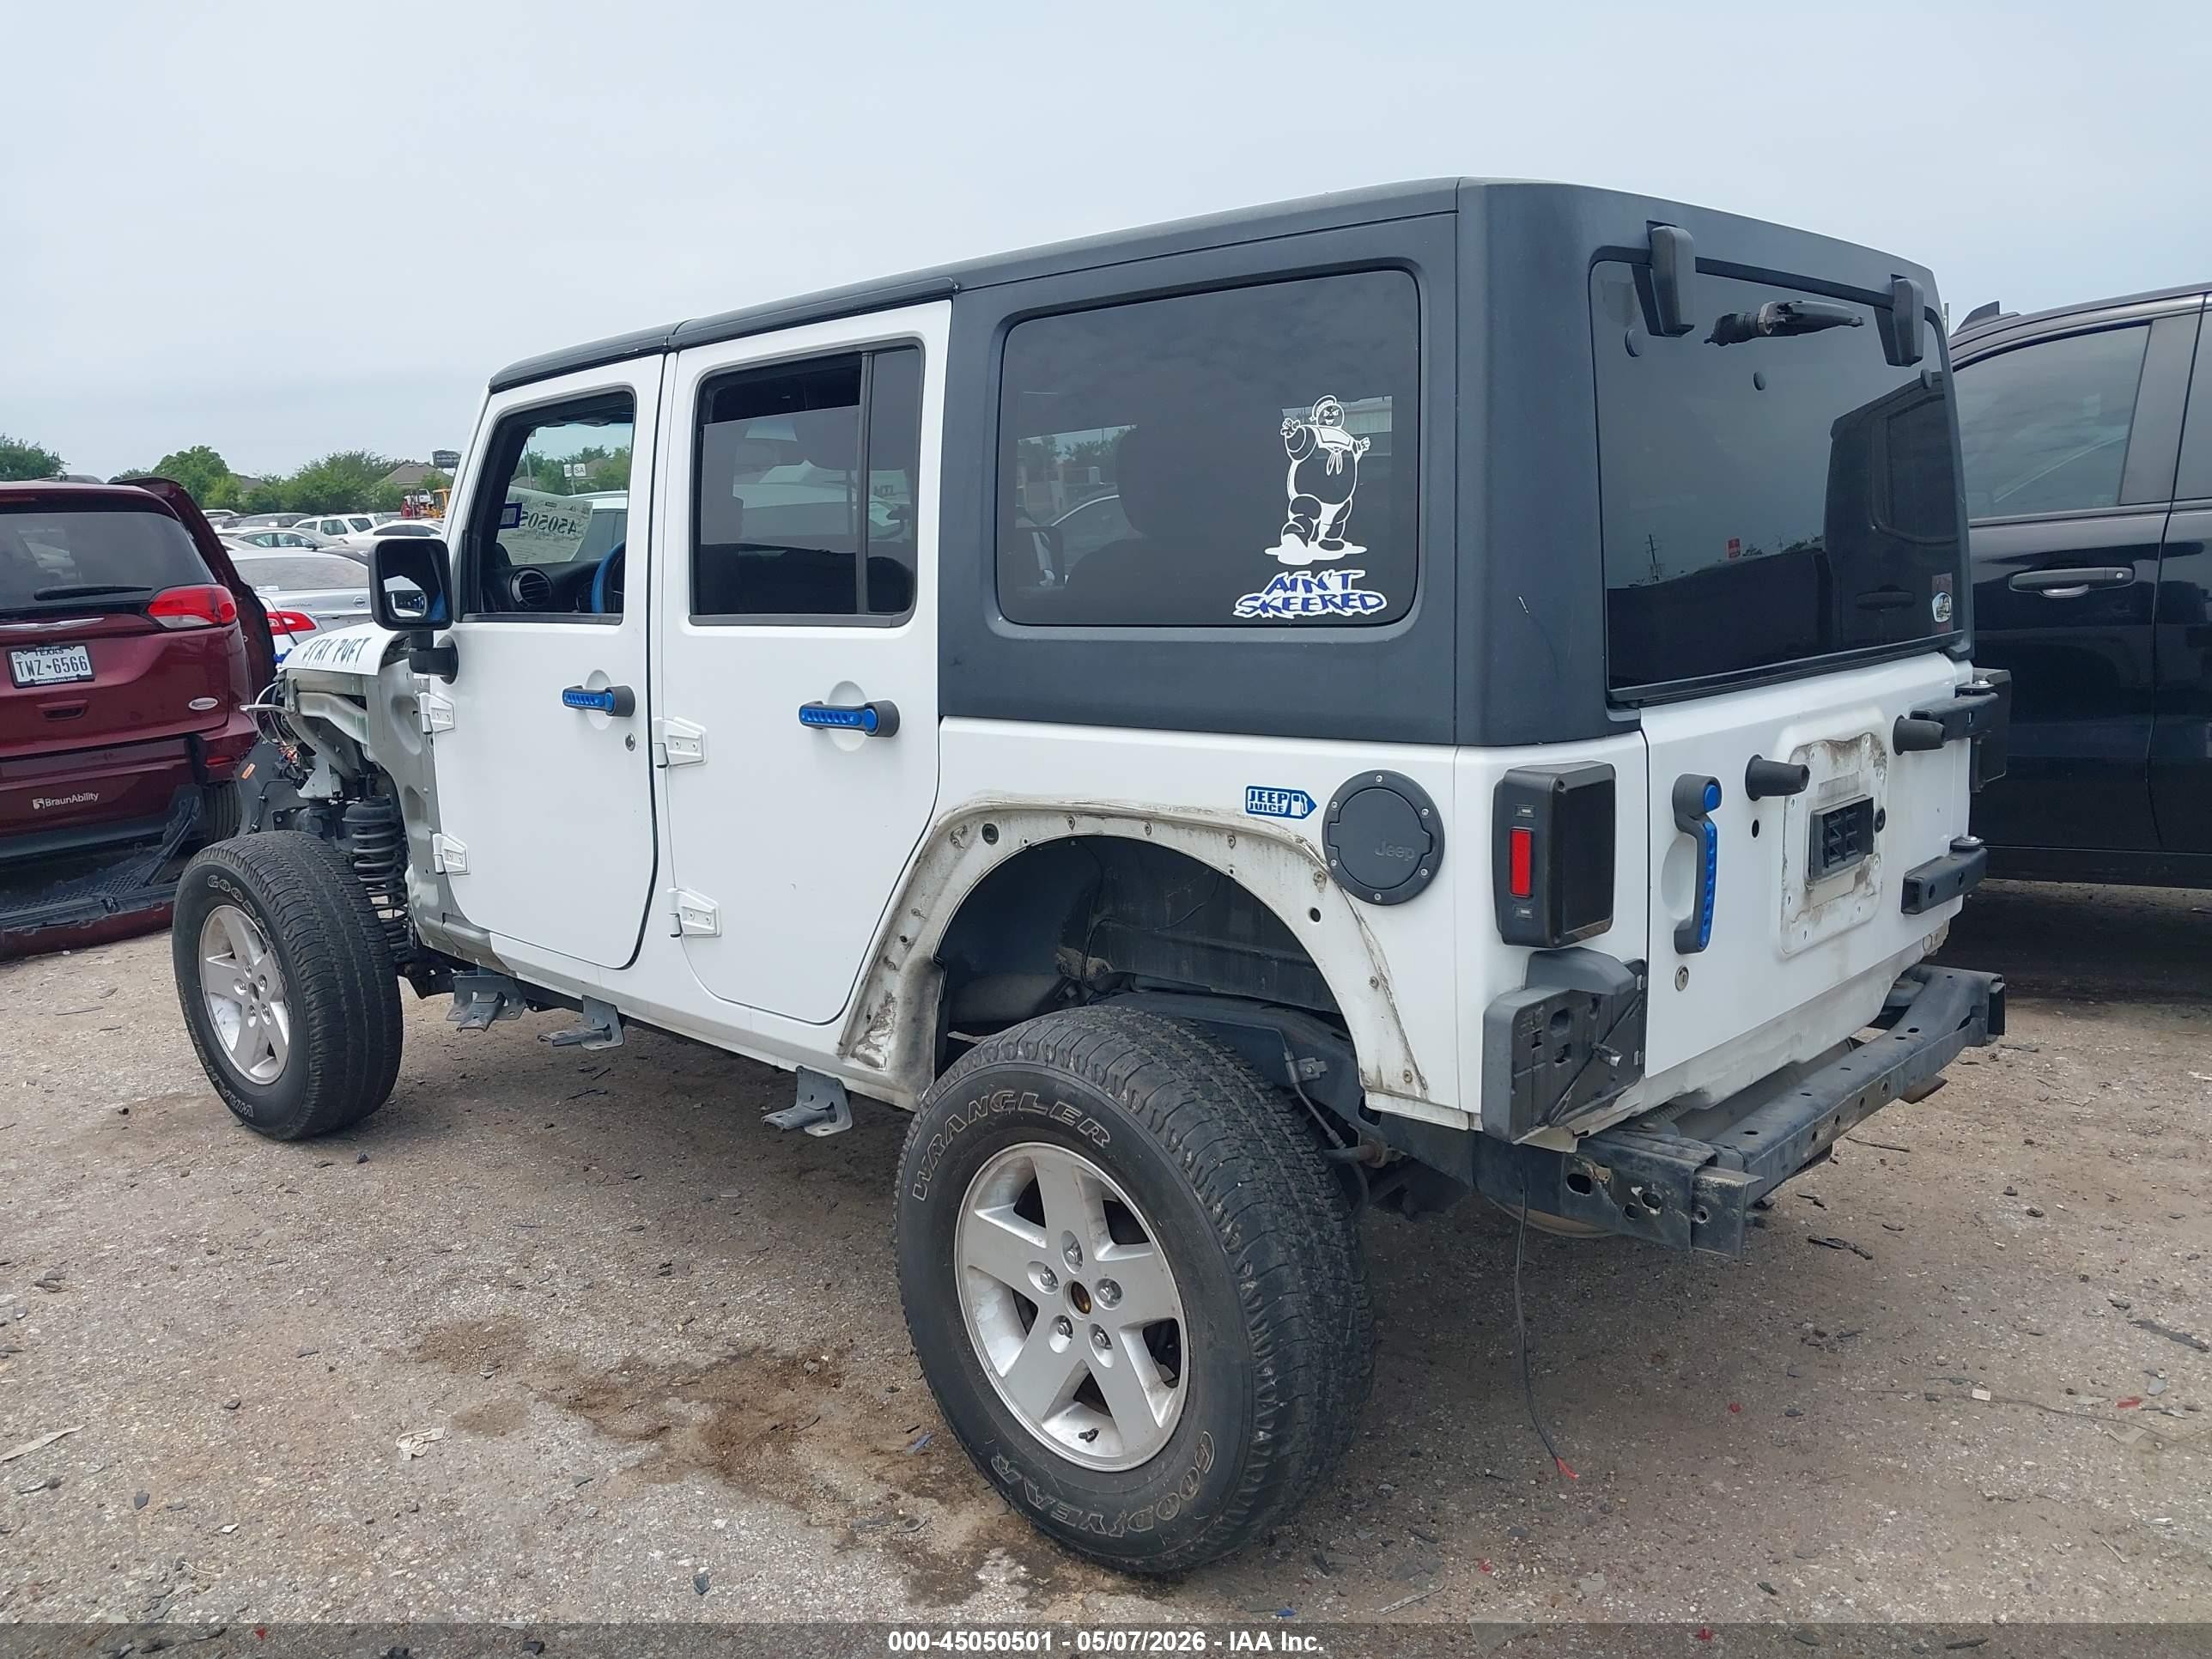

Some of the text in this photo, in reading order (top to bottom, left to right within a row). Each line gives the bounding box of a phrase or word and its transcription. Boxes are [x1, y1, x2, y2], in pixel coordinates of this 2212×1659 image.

[1264, 570, 1365, 595] AIN'T
[1233, 592, 1388, 619] SKEERED
[15, 655, 88, 678] TWZ 6566
[45, 792, 100, 808] BraunAbility
[1249, 790, 1288, 805] JEEP
[1249, 802, 1285, 813] JUICE
[1374, 840, 1415, 861] Jeep
[912, 1090, 1111, 1202] WRANGLER
[990, 1430, 1216, 1538] GOODYEAR
